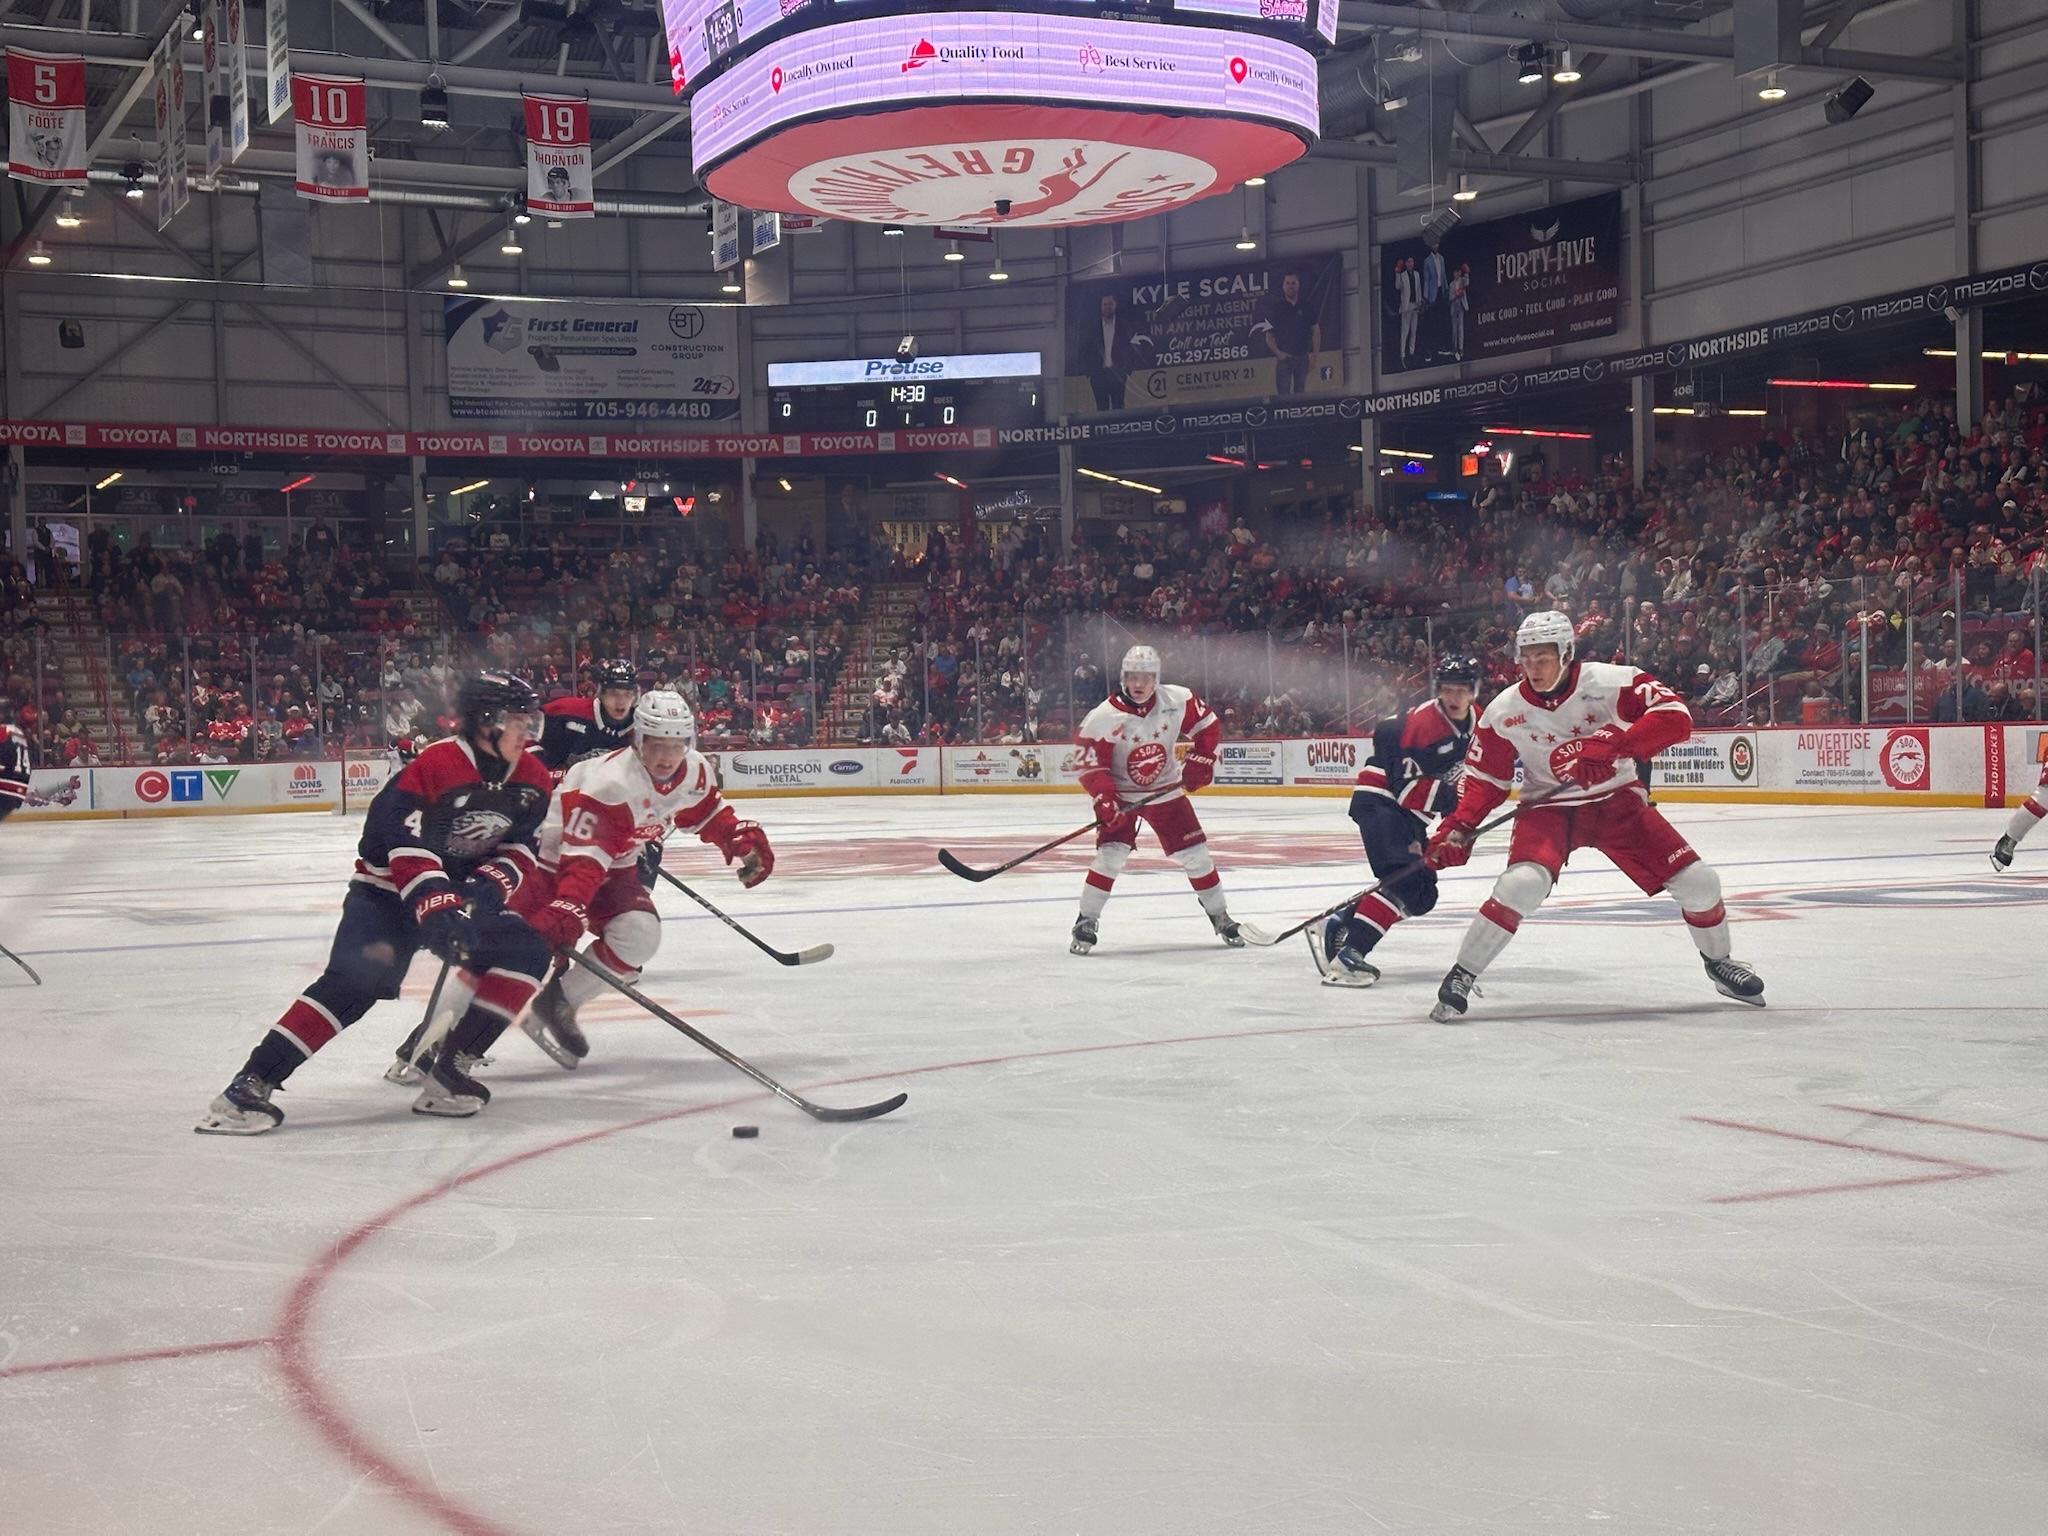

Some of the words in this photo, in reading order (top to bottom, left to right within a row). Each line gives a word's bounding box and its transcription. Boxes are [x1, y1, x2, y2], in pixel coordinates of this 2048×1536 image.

[709, 12, 733, 45] 14:38
[939, 45, 987, 62] Quality
[992, 46, 1023, 59] Food
[783, 63, 813, 83] Locally
[815, 56, 854, 75] Owned
[1105, 55, 1129, 69] Best
[1132, 56, 1176, 71] Service
[34, 64, 57, 103] 5
[1250, 66, 1279, 85] Locally
[1281, 75, 1304, 90] Owned
[310, 85, 348, 123] 10
[28, 114, 65, 129] FOOTE
[540, 105, 575, 141] 19
[307, 133, 355, 150] FRANCIS
[534, 150, 584, 166] THORNTON
[1496, 236, 1595, 284] FORTY-FIVE
[1132, 281, 1190, 305] KYLE
[1200, 271, 1269, 297] SCALI
[1523, 273, 1568, 292] SOCIAL
[1215, 299, 1258, 315] AGENT
[527, 318, 568, 332] First
[572, 318, 639, 332] General
[1167, 321, 1194, 334] ANY
[1196, 314, 1253, 331] MARKET!
[1209, 330, 1235, 348] Text
[651, 344, 724, 352] CONSTRUCTION
[671, 352, 704, 360] GROUP
[1155, 345, 1249, 366] 705.297.5866
[864, 359, 945, 376] Prouse
[999, 425, 1090, 443] NORTHSIDE
[1365, 388, 1441, 413] NORTHSIDE
[1688, 327, 1769, 361] NORTHSIDE
[1176, 369, 1240, 385] CENTURY
[1243, 368, 1255, 380] 21
[890, 385, 925, 402] 14:38
[1673, 384, 1692, 397] 106
[1031, 394, 1036, 406] 1
[584, 402, 711, 418] 705-946-4480
[782, 403, 791, 416] 0
[905, 412, 910, 424] 1
[943, 406, 955, 424] 0
[866, 410, 877, 427] 0
[99, 427, 171, 444] TOYOTA
[205, 430, 308, 448] NORTHSIDE
[315, 434, 382, 450] TOYOTA
[417, 437, 484, 452] TOYOTA
[519, 438, 585, 452] TOYOTA
[615, 439, 710, 453] NORTHSIDE
[715, 439, 779, 453] TOYOTA
[811, 435, 874, 450] TOYOTA
[907, 431, 970, 447] TOYOTA
[212, 464, 239, 475] 103
[636, 471, 660, 480] 104
[1634, 680, 1676, 707] 25
[1558, 740, 1583, 758] SOO
[1798, 732, 1871, 750] ADVERTISE
[1899, 738, 1914, 749] SOO
[1073, 746, 1098, 766] 24
[1139, 744, 1157, 757] SOO
[1223, 747, 1247, 759] IBEW
[1307, 741, 1356, 767] CHUCK'S
[1671, 746, 1720, 757] Steamfitters,
[1817, 750, 1851, 767] HERE
[1989, 725, 1999, 791] FLOHOCKEY
[750, 763, 822, 775] HENDERSON
[832, 763, 860, 772] Carrier
[1653, 760, 1677, 770] mbers
[1678, 760, 1692, 770] and
[1693, 760, 1725, 770] Welders
[1802, 769, 1825, 777] Contact
[137, 771, 239, 801] CTV
[289, 780, 322, 789] LYONS
[769, 774, 802, 783] METAL
[889, 777, 925, 785] FLOHOCKEY
[1664, 772, 1685, 783] Since
[404, 809, 423, 838] 4
[564, 806, 599, 841] 16
